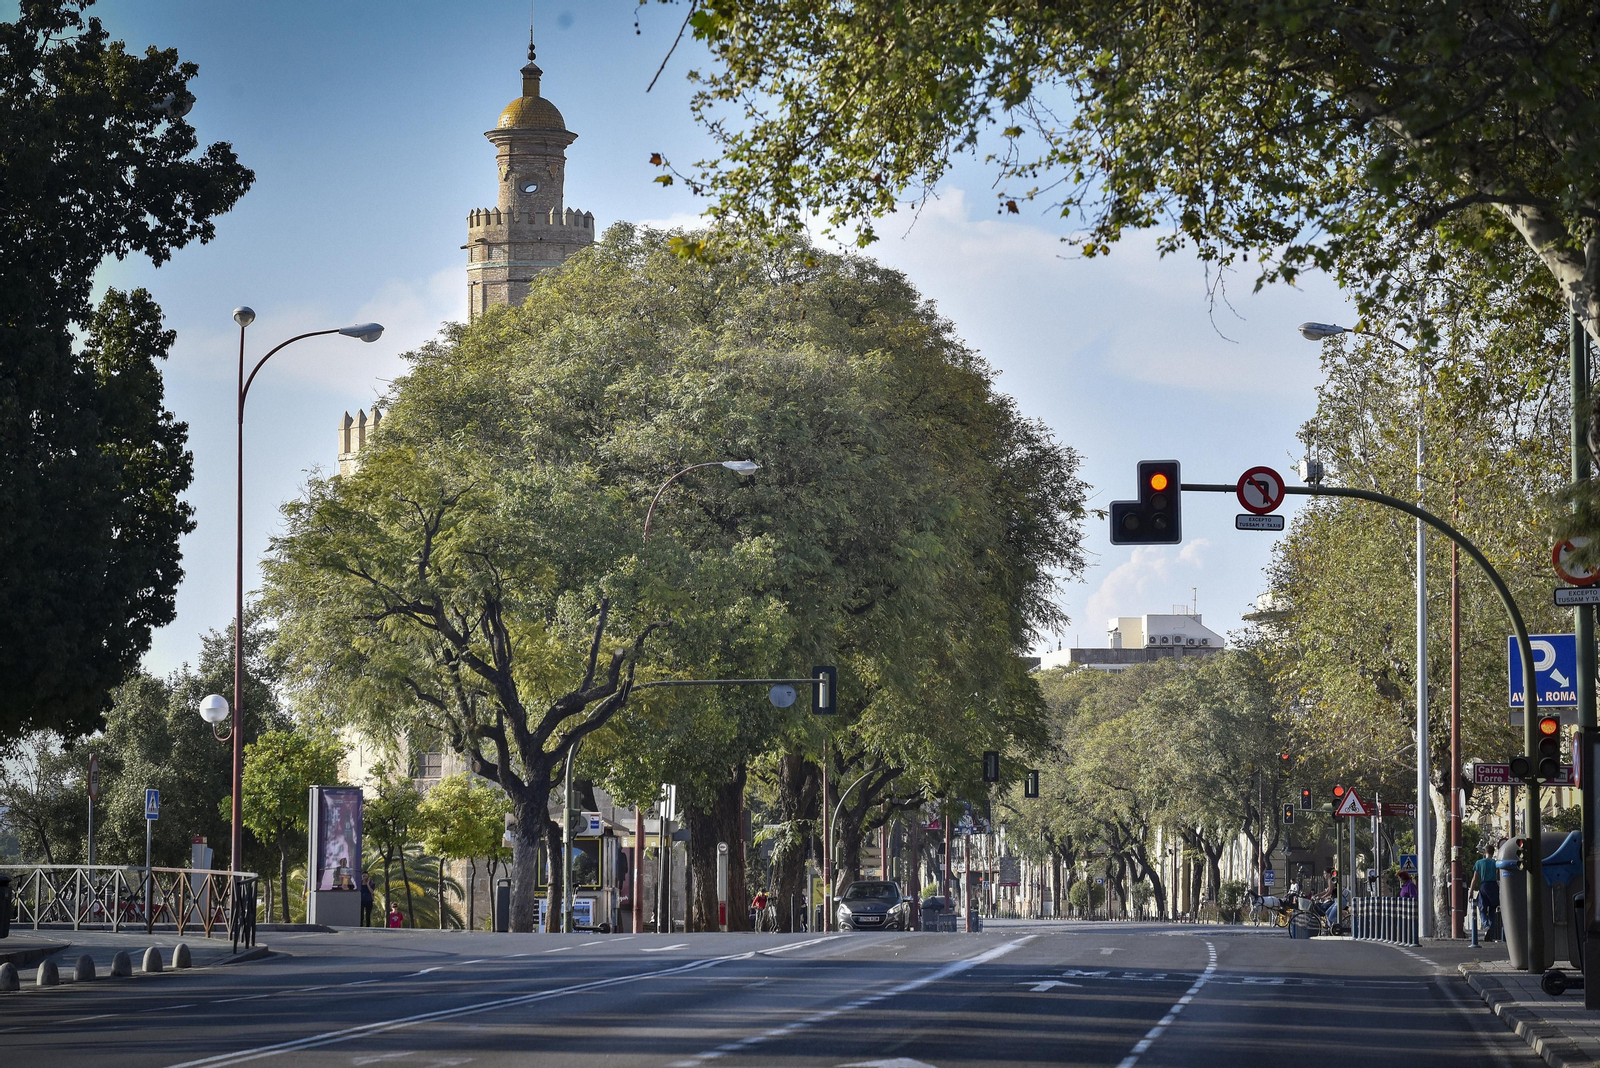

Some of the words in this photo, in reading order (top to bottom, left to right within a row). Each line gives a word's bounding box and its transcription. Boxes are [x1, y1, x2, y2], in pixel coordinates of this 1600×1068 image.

[1545, 691, 1577, 702] ROMA
[1478, 766, 1504, 774] Caixa
[1478, 774, 1503, 782] Torre
[1507, 775, 1523, 783] Se
